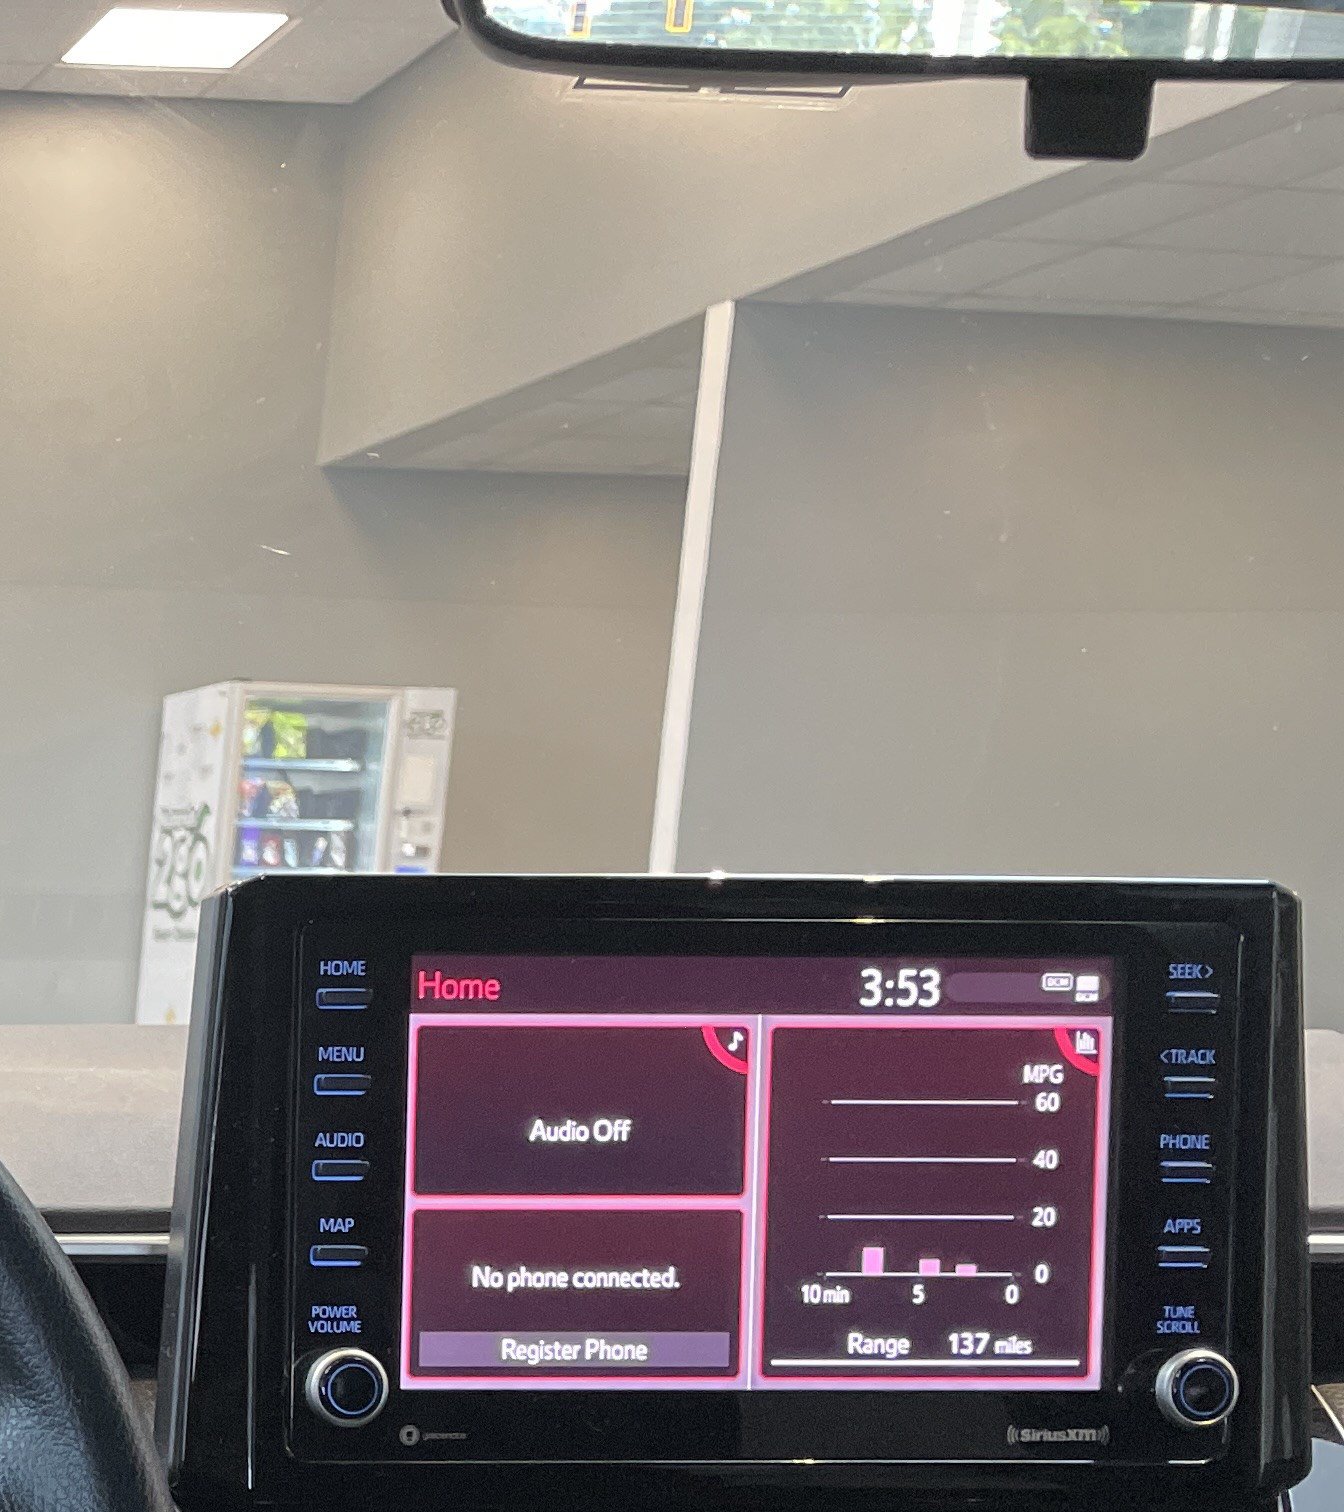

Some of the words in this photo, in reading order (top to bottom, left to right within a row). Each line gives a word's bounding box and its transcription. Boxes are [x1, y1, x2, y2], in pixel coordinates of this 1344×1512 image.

[319, 960, 366, 976] HOME
[418, 970, 501, 1000] Home
[859, 968, 941, 1007] 3:53
[318, 1046, 364, 1062] MENU
[1022, 1064, 1064, 1085] MPG
[1035, 1092, 1060, 1112] 60
[315, 1132, 364, 1148] AUDIO
[529, 1119, 590, 1142] Audio
[593, 1119, 632, 1142] Off
[1160, 1134, 1210, 1150] PHONE
[1032, 1150, 1058, 1169] 40
[319, 1218, 354, 1233] MAP
[1031, 1208, 1057, 1228] 20
[1163, 1218, 1202, 1235] APPS
[471, 1265, 503, 1288] No
[507, 1266, 568, 1294] phone
[573, 1266, 681, 1289] connected.
[1034, 1264, 1049, 1285] 0
[800, 1285, 820, 1304] 10
[823, 1286, 850, 1304] min
[913, 1285, 925, 1304] 5
[1005, 1284, 1019, 1304] 0
[312, 1305, 357, 1318] POWER
[1163, 1305, 1195, 1319] TUNE
[308, 1320, 362, 1333] VOLUME
[1156, 1320, 1200, 1334] SCROLL
[501, 1338, 581, 1365] Register
[585, 1338, 647, 1362] Phone
[847, 1332, 910, 1358] Range
[948, 1332, 990, 1355] 137
[994, 1336, 1032, 1355] miles
[1020, 1427, 1097, 1442] SiriusXM
